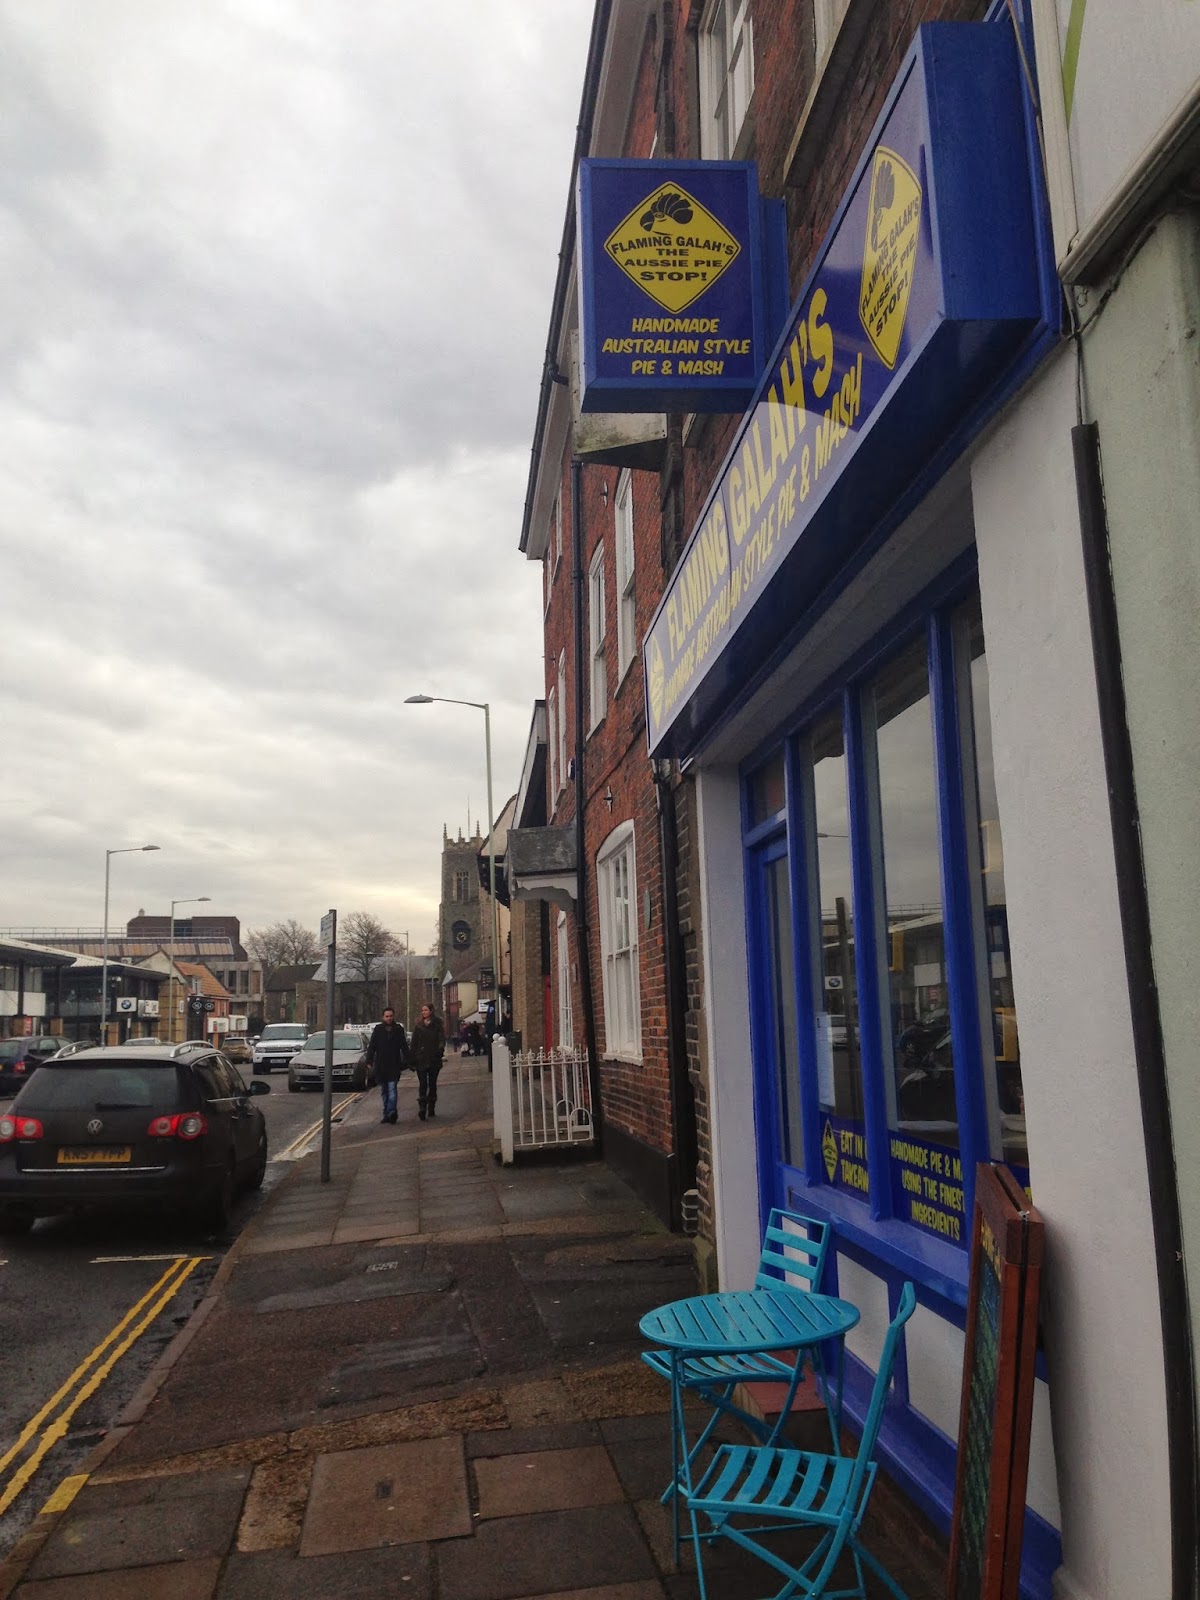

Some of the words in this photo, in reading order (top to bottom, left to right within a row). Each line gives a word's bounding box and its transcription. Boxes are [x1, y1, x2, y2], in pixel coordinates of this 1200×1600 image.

[611, 236, 672, 254] FLAMING
[676, 236, 734, 255] GALAH'S
[656, 248, 689, 256] THE
[862, 241, 889, 317] FLAMING
[890, 196, 919, 248] GALAH'S
[624, 259, 688, 267] AUSSIE
[640, 271, 707, 281] STOP!
[881, 246, 898, 282] THE
[869, 266, 898, 328] AUSSIE
[900, 233, 915, 269] PIE
[876, 270, 908, 337] STOP!
[632, 318, 720, 333] HANDMADE
[602, 339, 698, 354] AUSTRALIAN
[704, 339, 751, 354] STYLE
[632, 360, 656, 375] PIE
[661, 361, 673, 374] &
[678, 360, 724, 375] MASH
[666, 500, 728, 662] FLAMING
[729, 288, 833, 546] GALAH'S
[744, 503, 775, 592] STYLE
[777, 465, 797, 541] PIE
[815, 352, 863, 480] MASH
[840, 1129, 853, 1157] EAT
[855, 1134, 863, 1160] IN
[890, 1138, 929, 1169] HANDMADE
[930, 1150, 943, 1174] PIE
[944, 1155, 951, 1177] &
[840, 1158, 869, 1193] TAKEAW
[901, 1169, 921, 1195] USING
[923, 1176, 938, 1201] THE
[911, 1200, 960, 1241] INGREDIENTS
